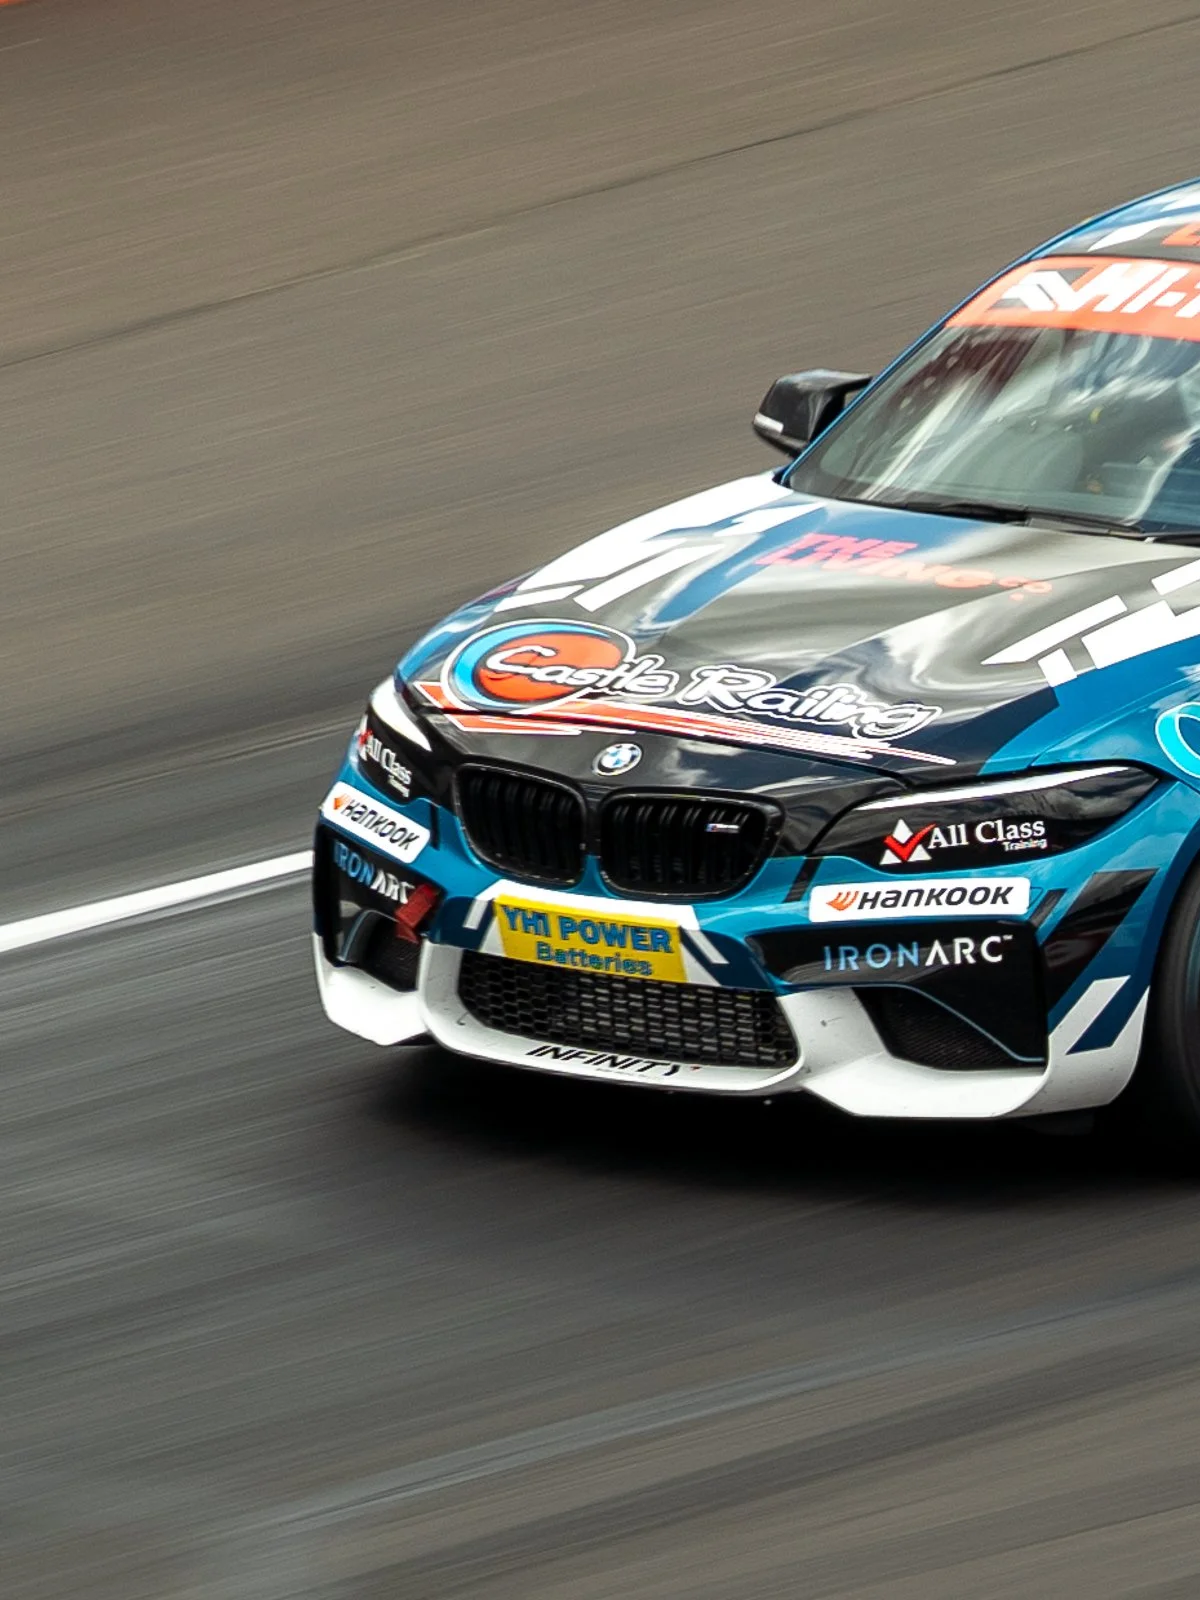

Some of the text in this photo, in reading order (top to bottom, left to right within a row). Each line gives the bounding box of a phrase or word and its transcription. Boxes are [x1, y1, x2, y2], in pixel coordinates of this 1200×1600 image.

[754, 532, 919, 566] THE
[482, 641, 938, 737] Castle Railing
[928, 819, 1046, 849] All Class
[1003, 839, 1047, 852] Training
[559, 916, 674, 953] POWER
[536, 941, 653, 976] Batteries
[525, 1045, 682, 1076] INFINITY
